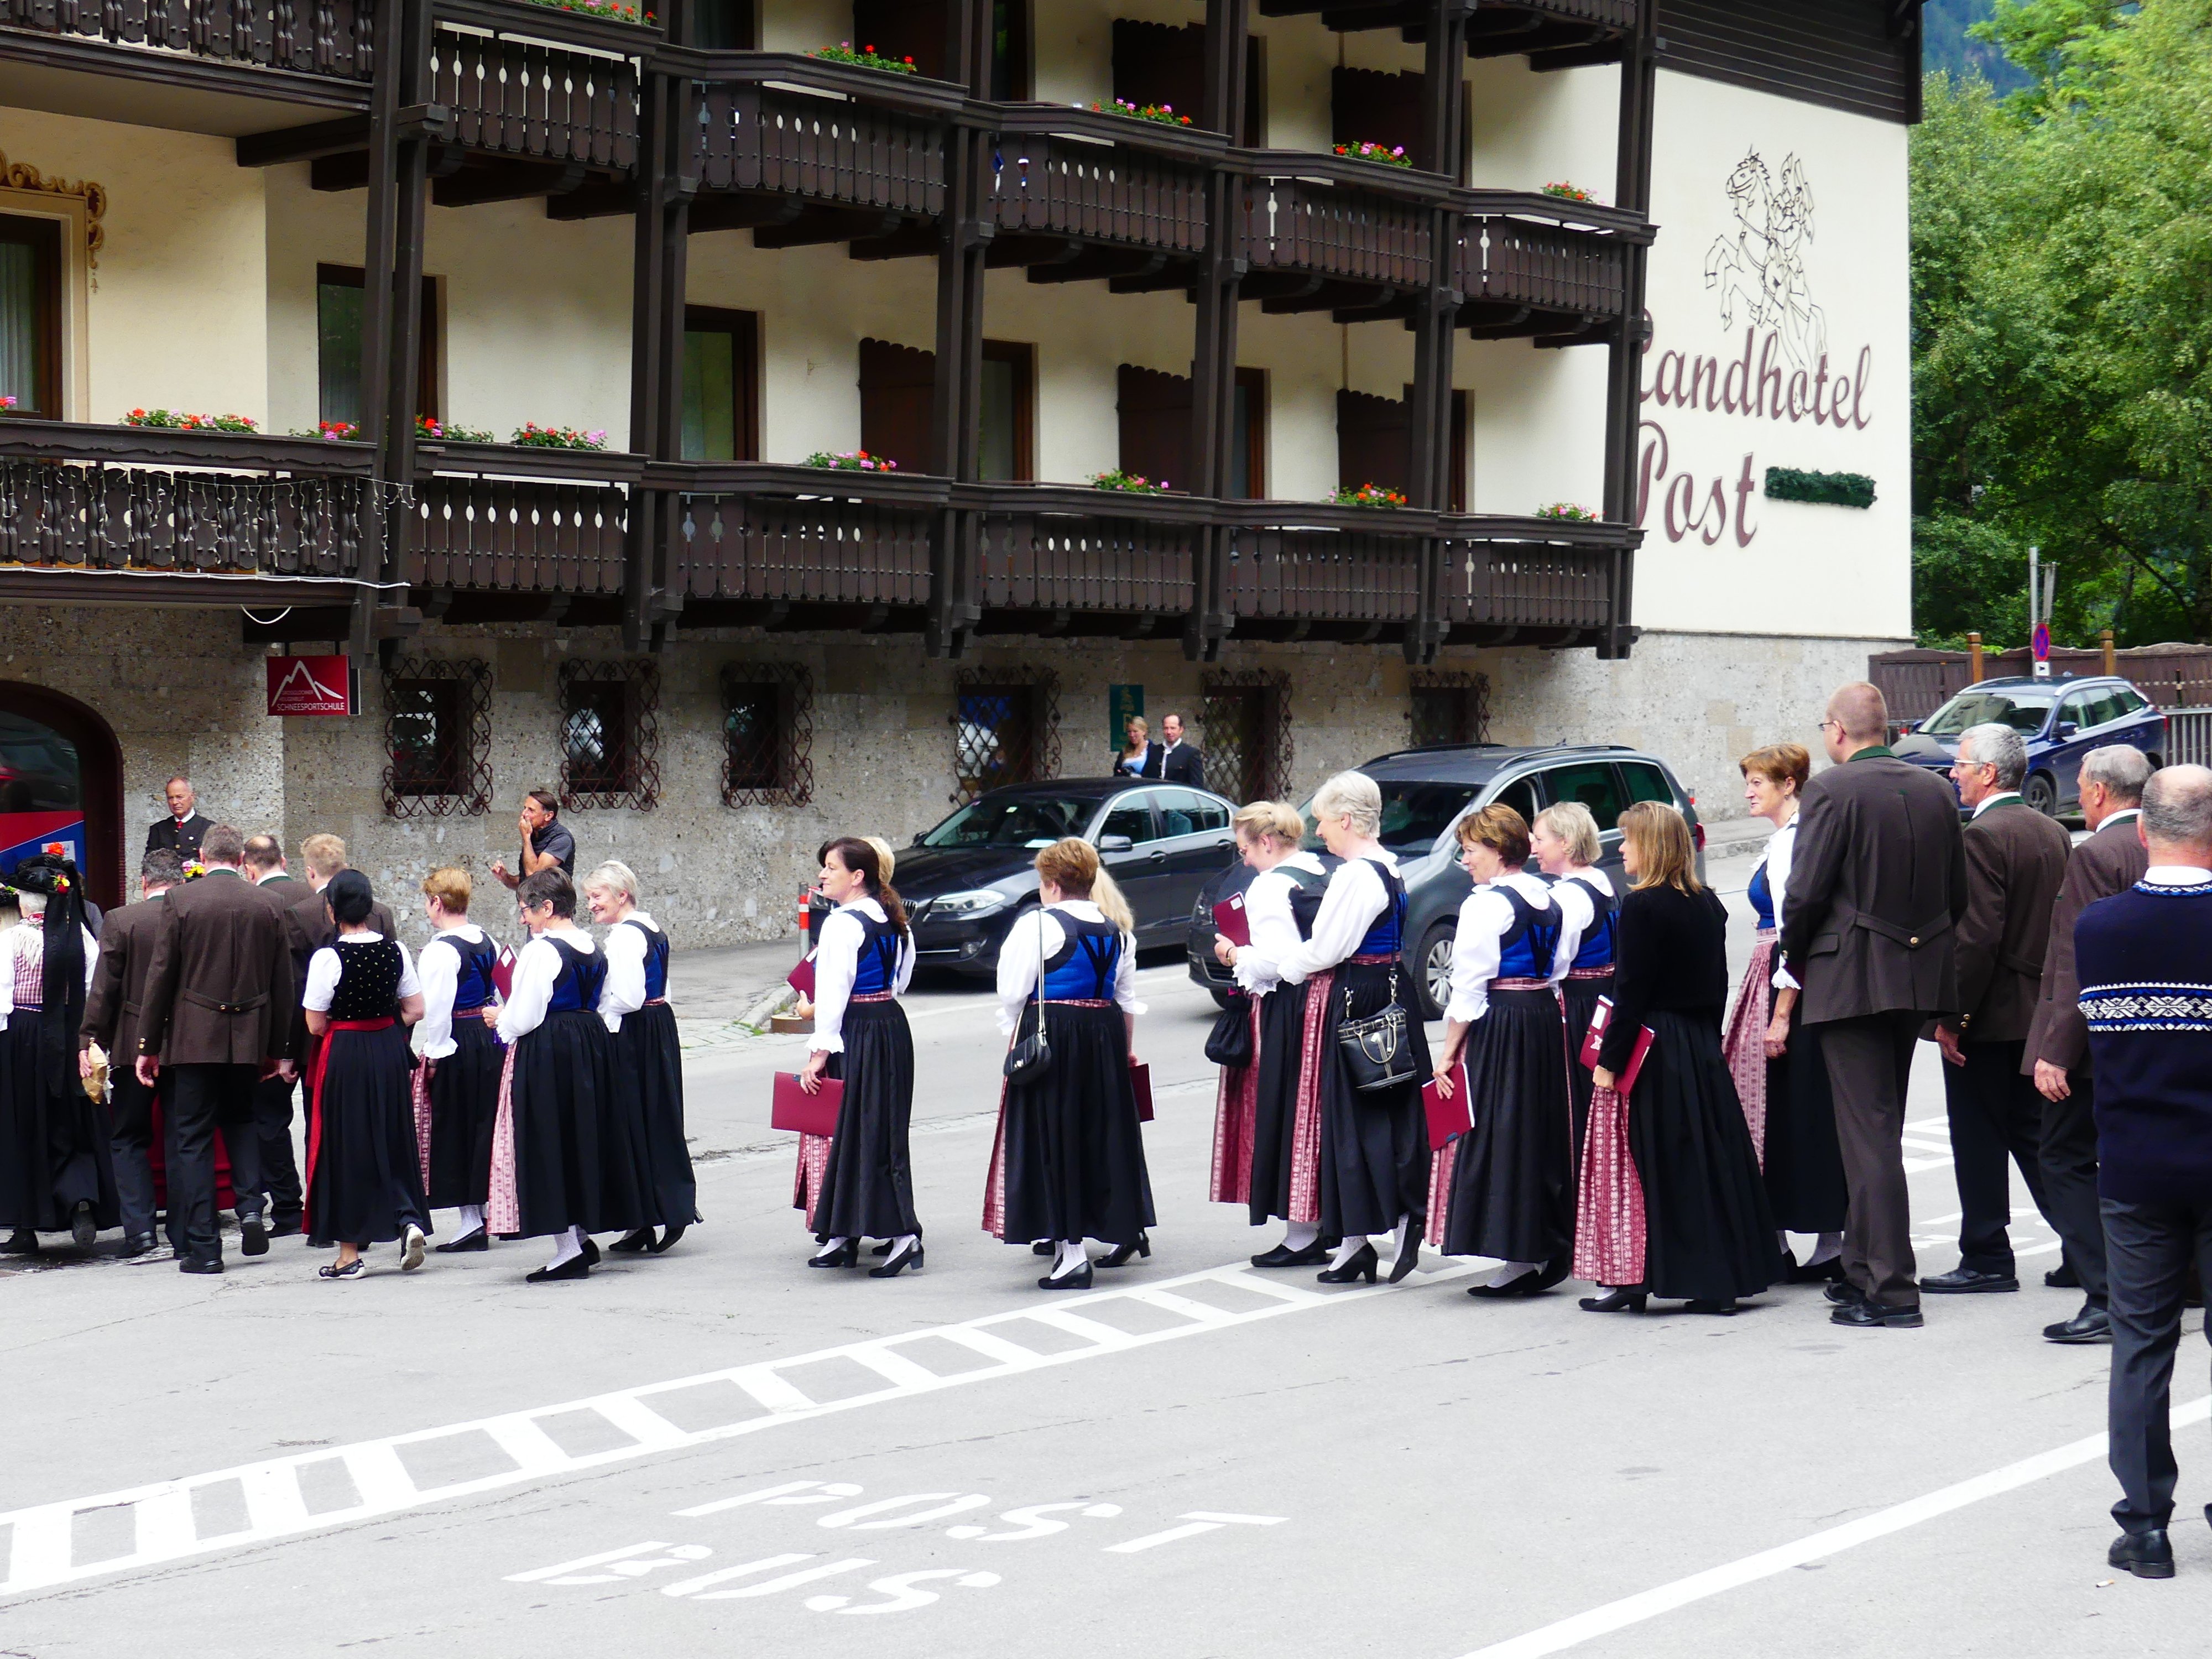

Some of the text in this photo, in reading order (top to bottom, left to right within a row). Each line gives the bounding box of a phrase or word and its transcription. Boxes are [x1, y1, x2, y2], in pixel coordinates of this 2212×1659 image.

[1636, 419, 1757, 548] Post
[277, 702, 345, 711] SCHNEESPORTSCHULE
[670, 1480, 1290, 1553] POST
[500, 1541, 1003, 1615] BUS
